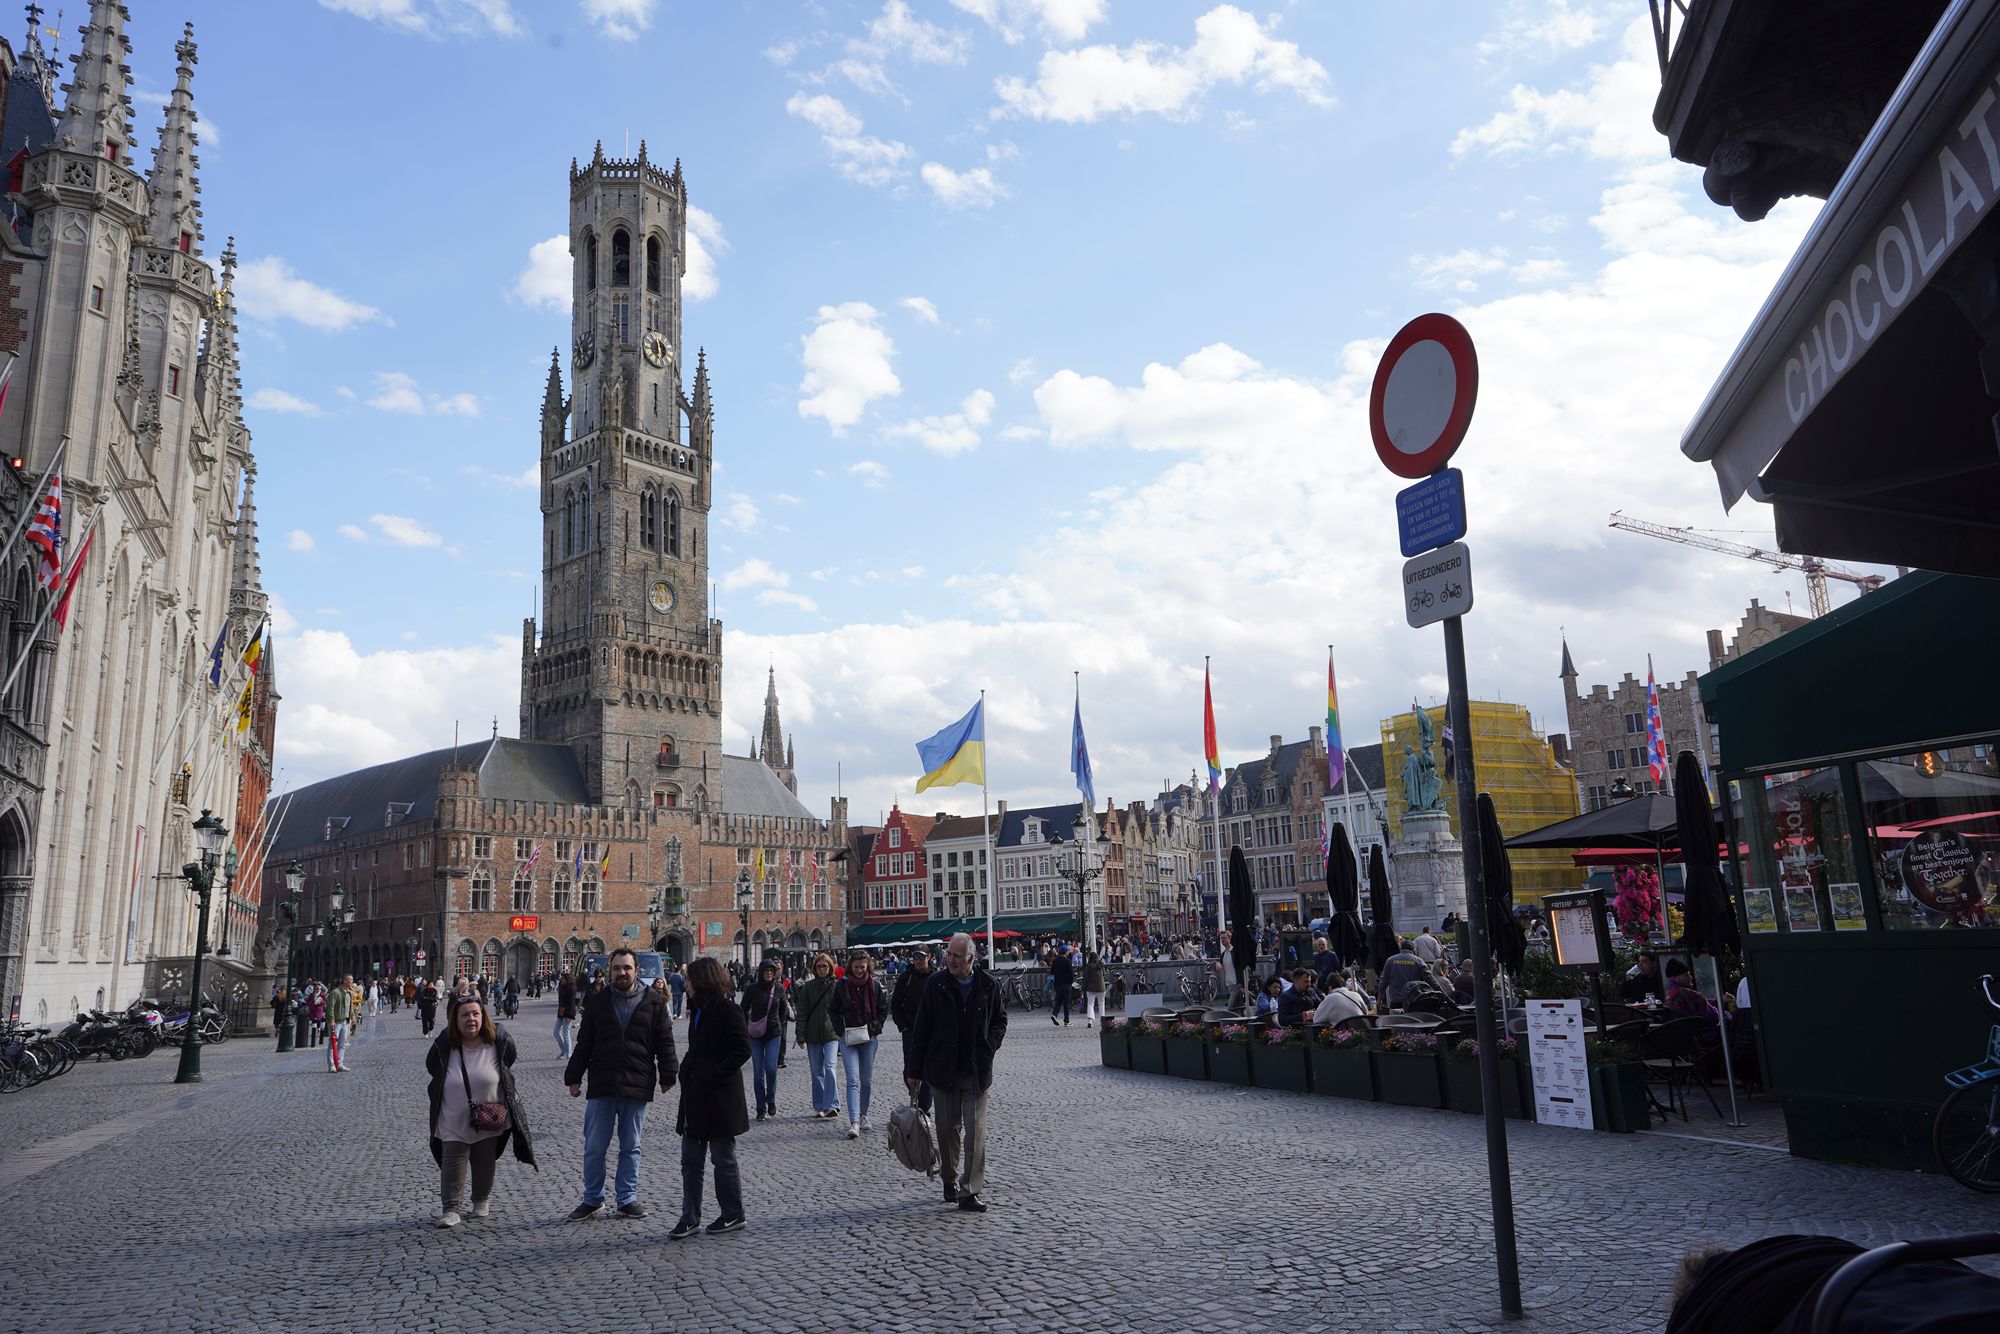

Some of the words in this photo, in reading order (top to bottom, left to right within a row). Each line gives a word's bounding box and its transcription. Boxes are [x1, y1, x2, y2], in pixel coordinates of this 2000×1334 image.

[1785, 73, 2000, 424] CHOCOLAT
[1402, 484, 1434, 504] UITGEZONDERD
[1436, 478, 1450, 490] LADEN
[1406, 501, 1423, 513] LOSSEN
[1424, 498, 1434, 506] VAN
[1416, 512, 1449, 533] UITGEZONDERD
[1406, 556, 1462, 584] UITGEZONDERD
[1918, 840, 1956, 850] Belgium's
[1910, 853, 1932, 861] finest
[1933, 848, 1970, 860] Classics
[1942, 855, 1974, 867] enjoyed
[1920, 866, 1968, 882] Together.
